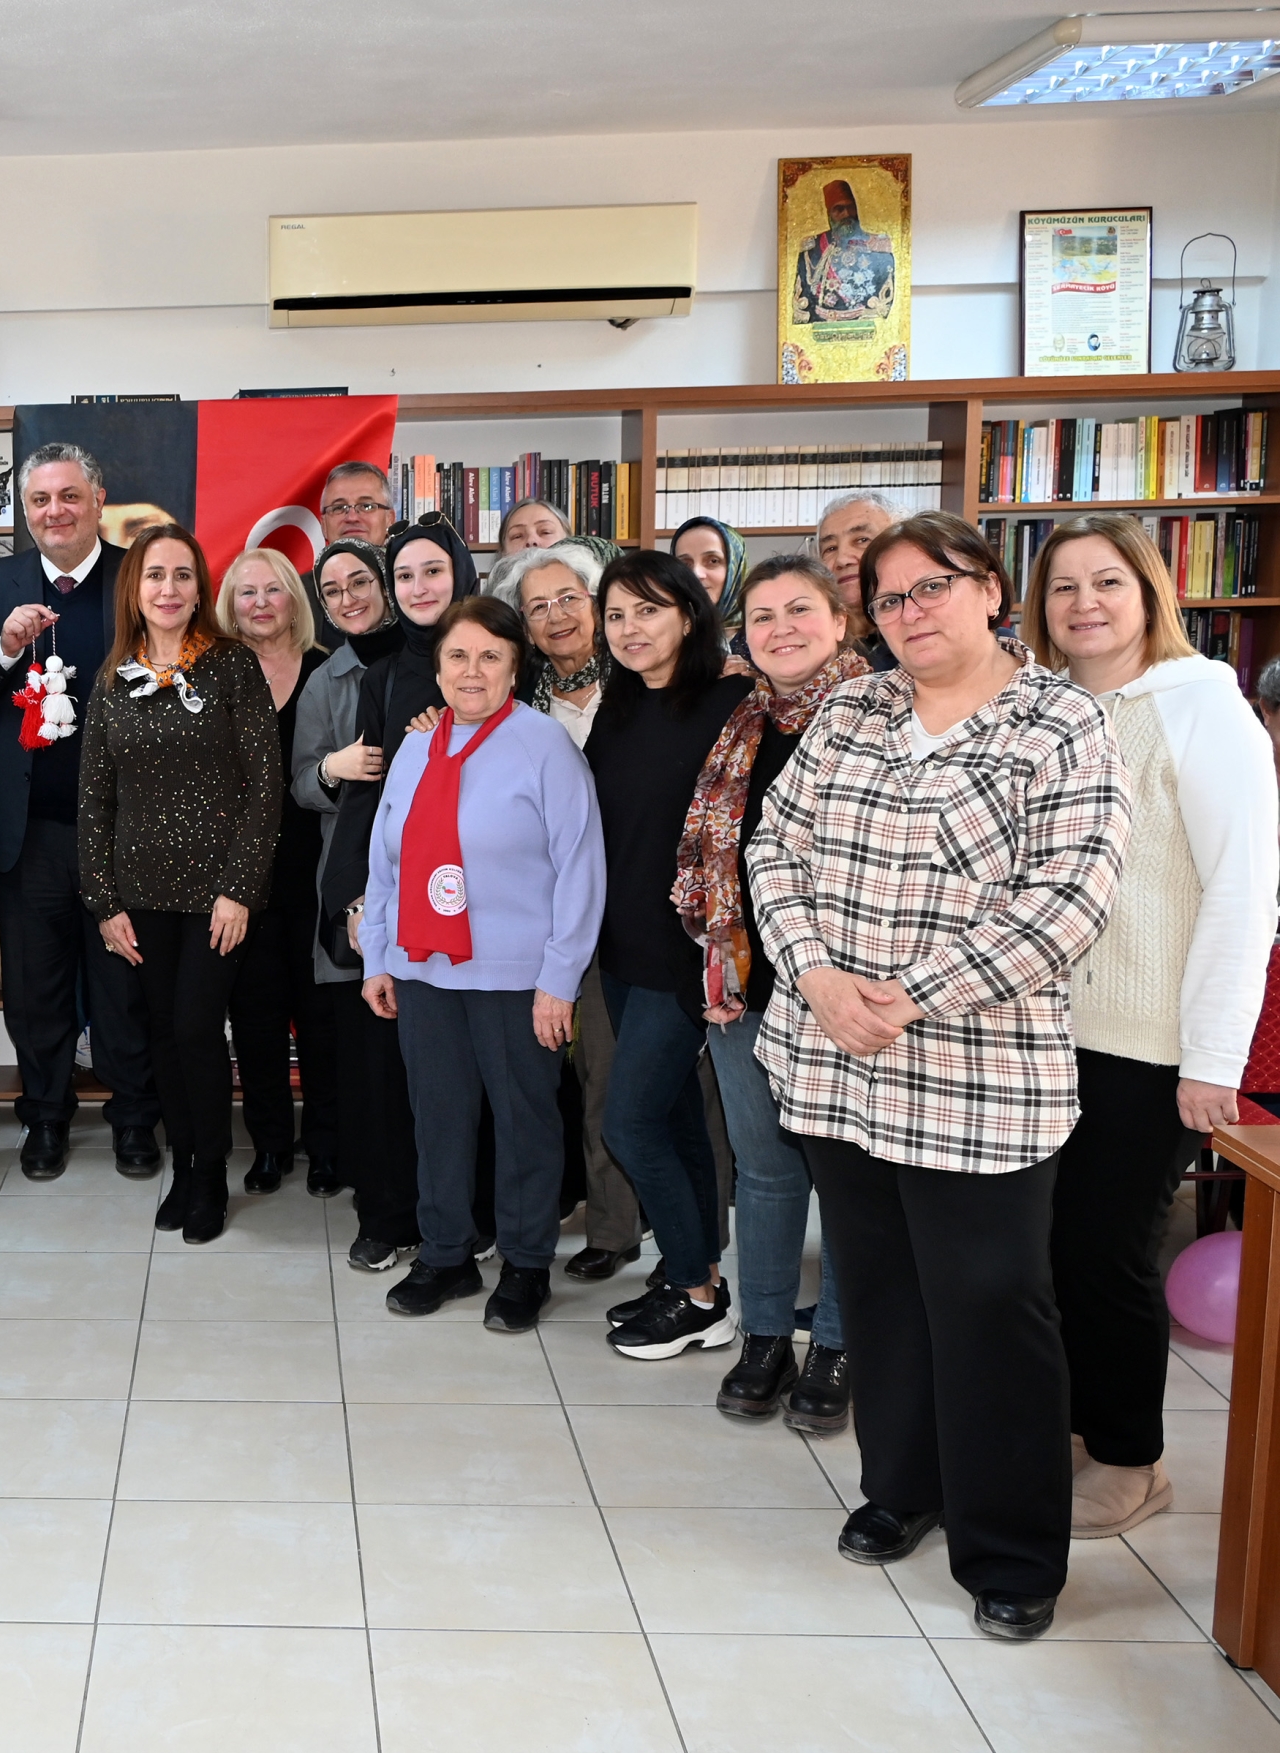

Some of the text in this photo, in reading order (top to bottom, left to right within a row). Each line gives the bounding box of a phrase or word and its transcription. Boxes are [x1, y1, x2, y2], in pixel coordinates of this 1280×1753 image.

[1027, 215, 1146, 225] KÖYÜMÜZÜN KURUCULARI
[590, 471, 599, 508] NUTUK
[601, 482, 609, 504] NUTUK
